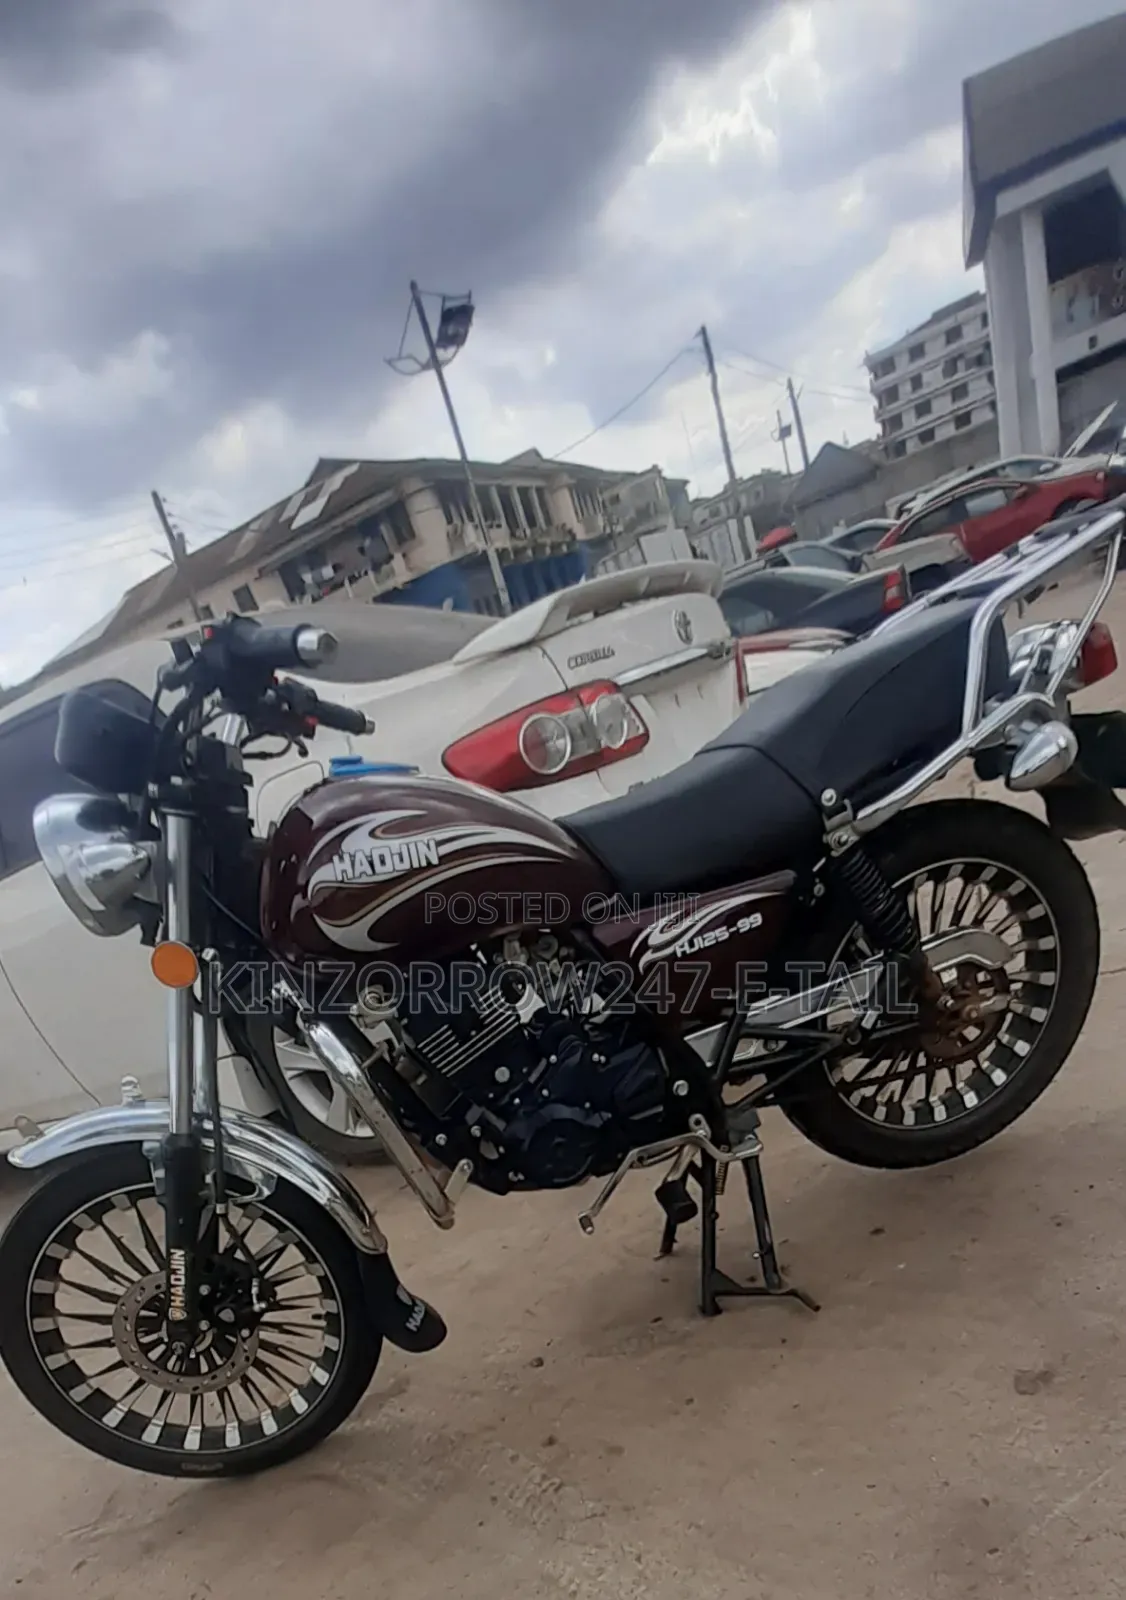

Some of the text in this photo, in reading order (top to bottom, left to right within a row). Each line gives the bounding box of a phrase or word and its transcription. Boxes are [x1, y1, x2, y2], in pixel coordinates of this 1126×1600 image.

[333, 838, 439, 881] HAOJIN
[675, 912, 763, 958] HJ125-99
[169, 1248, 186, 1307] HAOJIN
